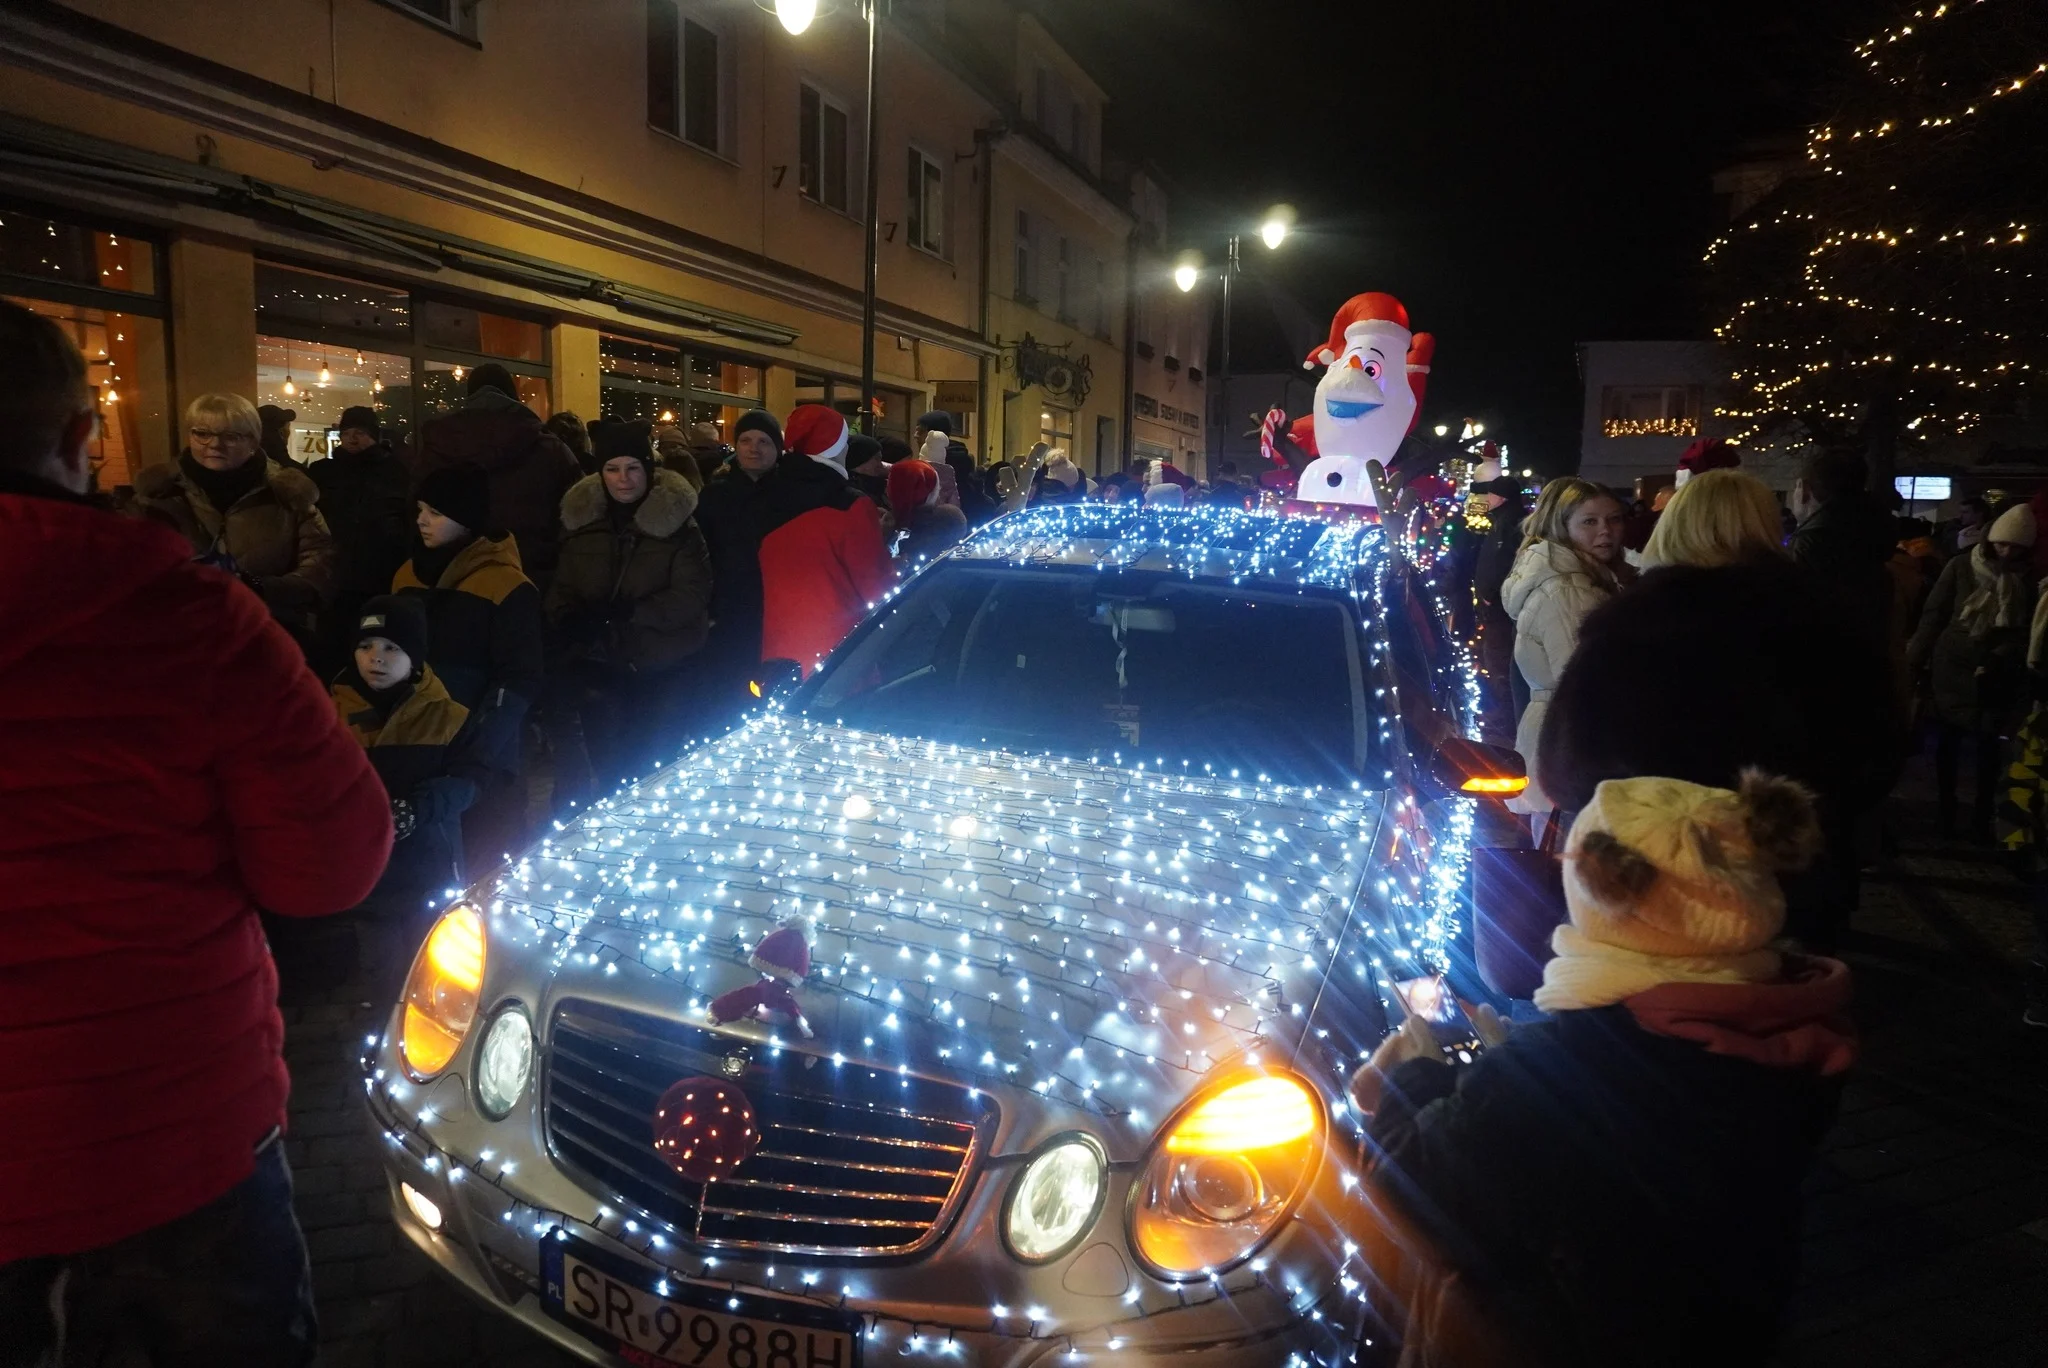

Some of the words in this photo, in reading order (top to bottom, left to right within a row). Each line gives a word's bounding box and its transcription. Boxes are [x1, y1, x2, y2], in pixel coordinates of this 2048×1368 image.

[548, 1280, 563, 1300] PL
[572, 1266, 633, 1341] SR
[654, 1305, 842, 1368] 9988H
